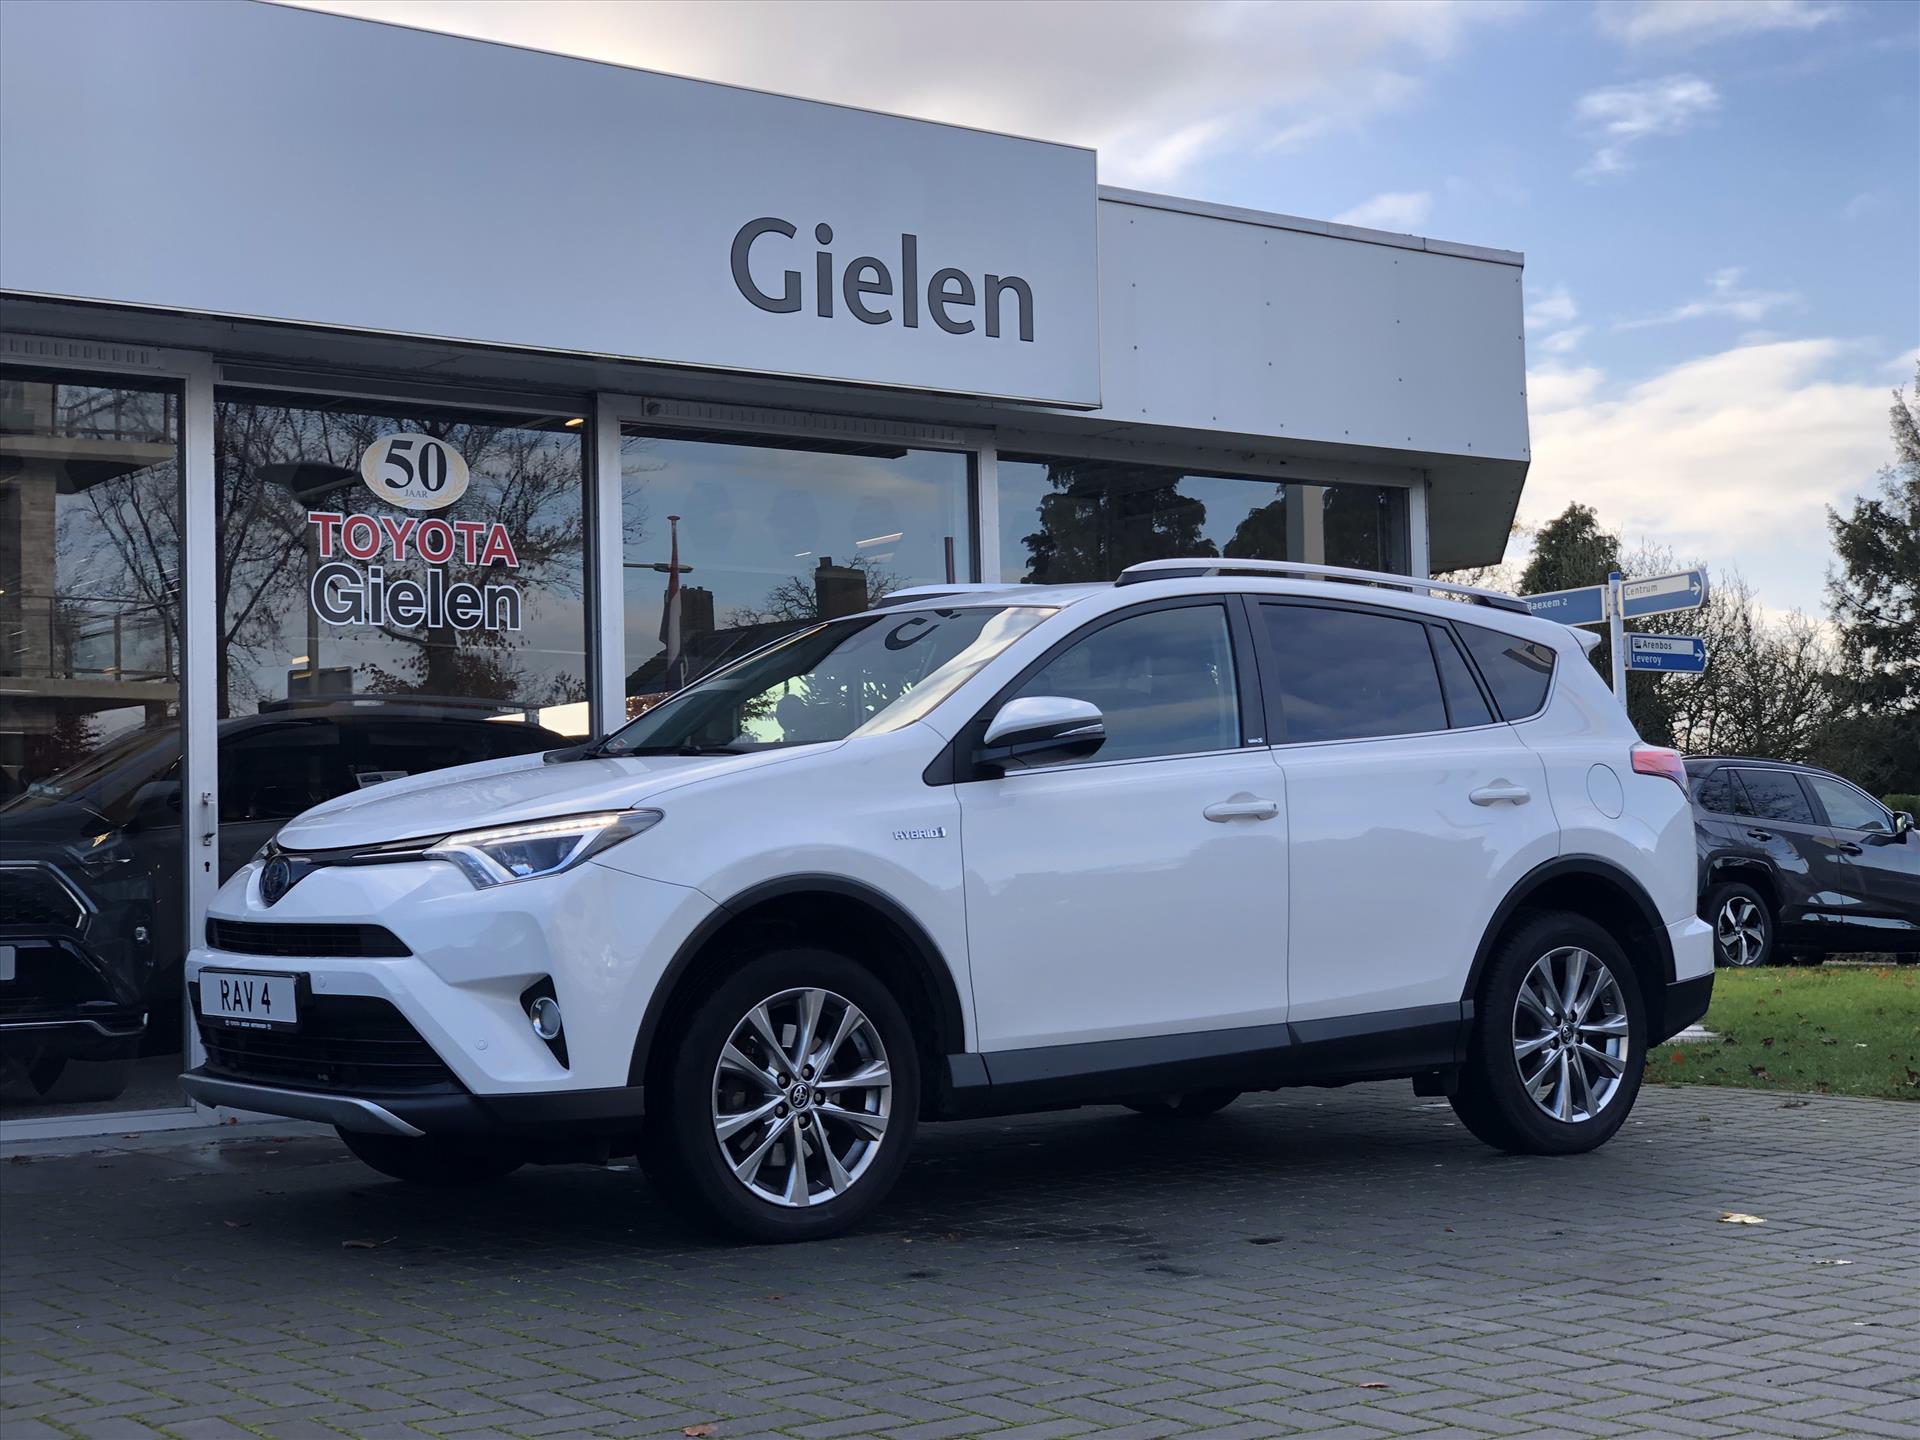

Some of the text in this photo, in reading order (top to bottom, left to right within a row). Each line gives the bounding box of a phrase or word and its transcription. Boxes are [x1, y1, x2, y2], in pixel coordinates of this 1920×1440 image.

[730, 217, 1034, 342] Gielen
[384, 439, 447, 492] 50
[405, 489, 428, 499] JAAR
[308, 511, 519, 567] TOYOTA
[1625, 583, 1658, 596] Centrum
[311, 562, 521, 631] Gielen
[1562, 598, 1568, 606] 2
[1642, 640, 1672, 650] Arenbos
[1632, 654, 1662, 666] Leveroy
[892, 828, 939, 840] HYBRID
[220, 979, 271, 1014] RAV 4
